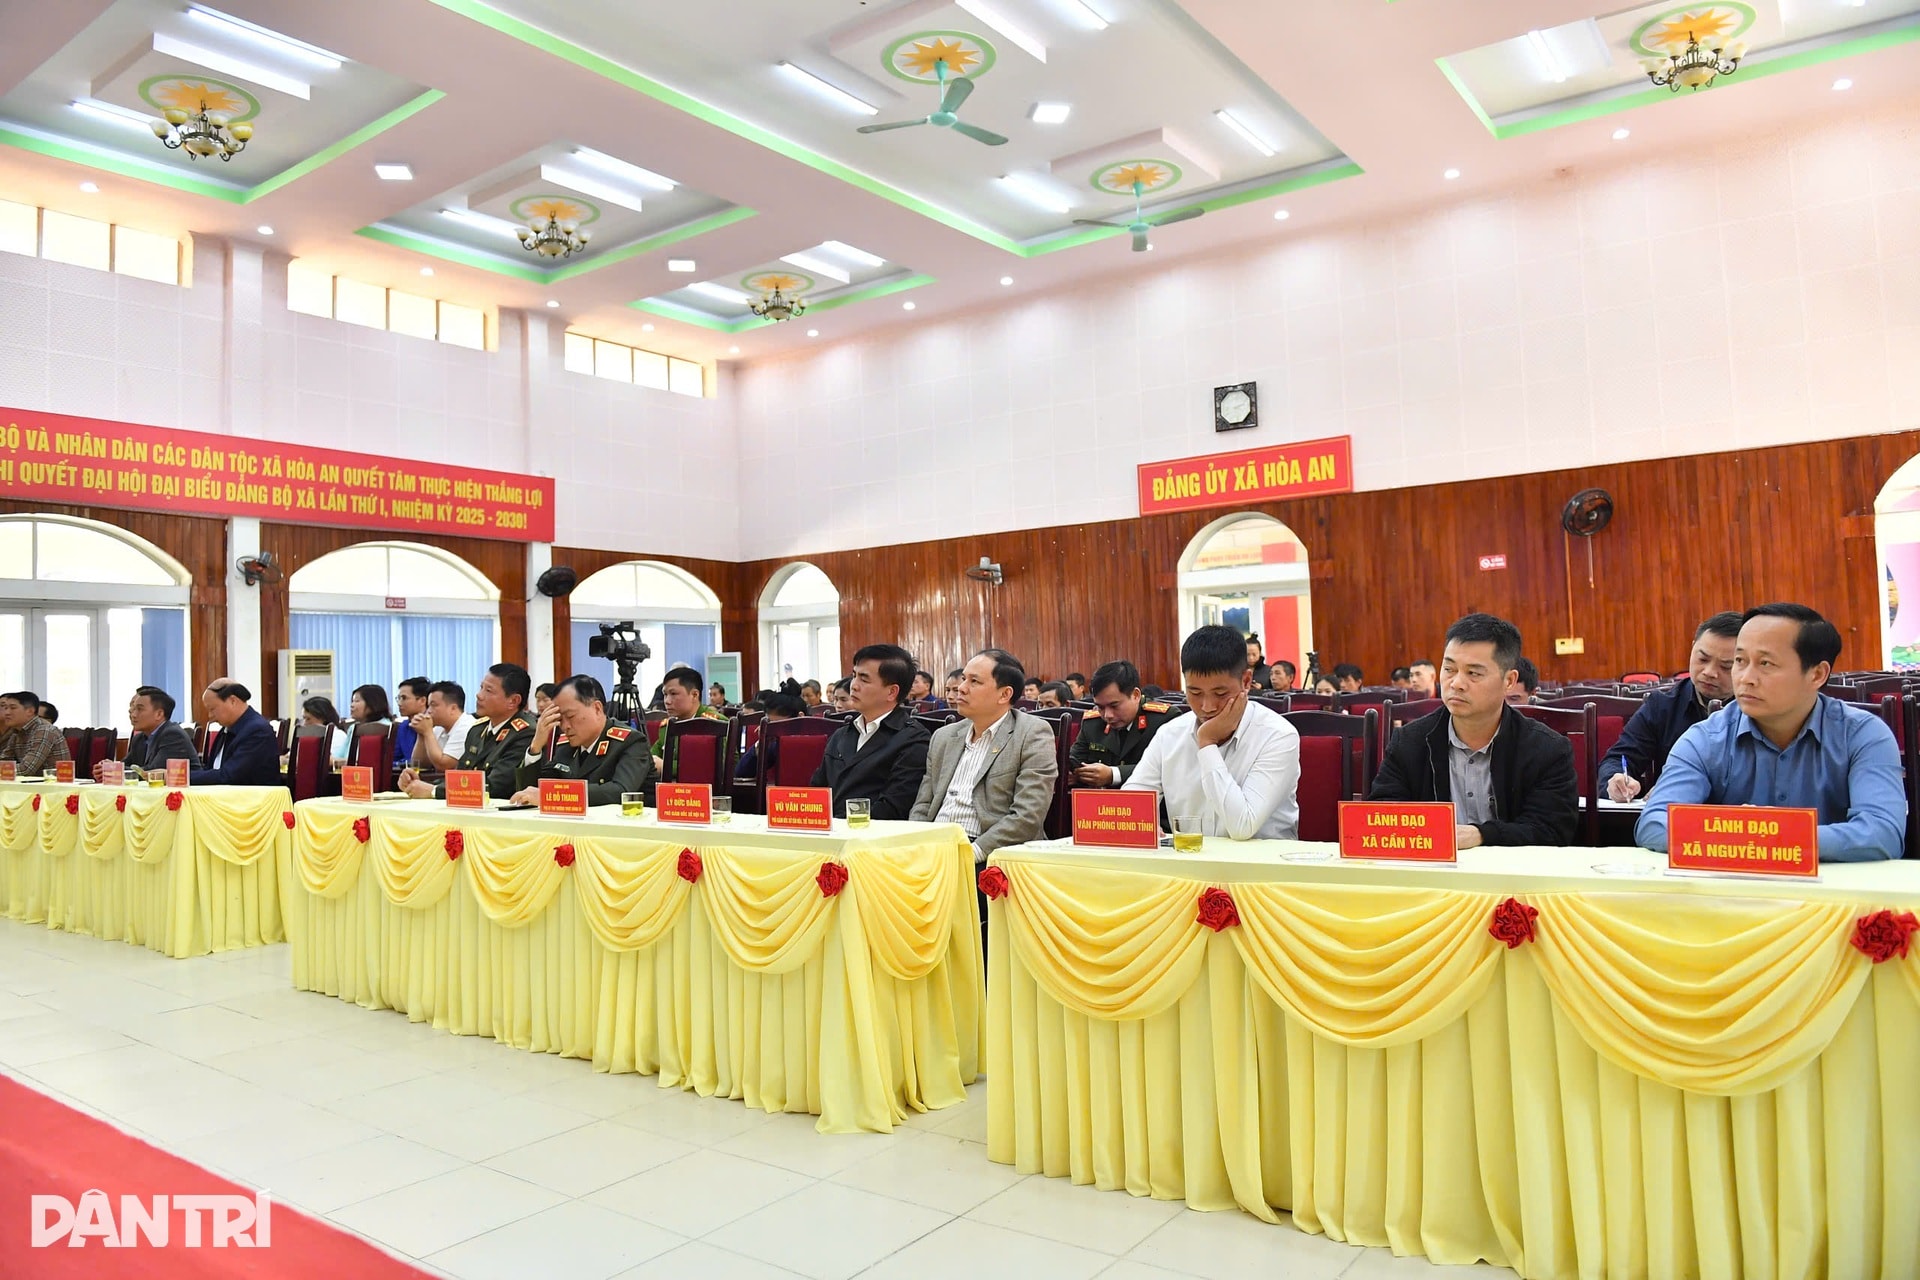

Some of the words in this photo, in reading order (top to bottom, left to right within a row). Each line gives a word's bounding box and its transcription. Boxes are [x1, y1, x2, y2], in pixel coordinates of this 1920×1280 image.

[25, 427, 50, 452] VÀ
[55, 432, 106, 459] NHÂN
[112, 437, 148, 462] DÂN
[153, 442, 186, 467] CÁC
[191, 446, 224, 471] DÂN
[229, 451, 258, 477] TỘC
[262, 456, 282, 478] XÃ
[319, 464, 339, 484] AN
[343, 465, 385, 489] QUYẾT
[388, 470, 416, 492] TÂM
[419, 476, 451, 499] THỰC
[454, 478, 482, 503] HIỆN
[485, 480, 522, 504] THẮNG
[525, 488, 543, 509] LỢI
[1152, 467, 1201, 501] ĐẢNG
[1205, 462, 1229, 495] ỦY
[1234, 460, 1259, 491] XÃ
[1264, 455, 1302, 487] HÒA
[1308, 454, 1336, 482] AN
[19, 459, 78, 487] QUYẾT
[82, 468, 112, 494] ĐẠI
[118, 469, 147, 496] HỘI
[151, 477, 180, 500] ĐẠI
[185, 473, 221, 501] BIỂU
[226, 476, 268, 505] ĐẢNG
[272, 486, 292, 511] BỘ
[296, 486, 316, 509] XÃ
[350, 493, 378, 515] THỨ
[391, 498, 434, 523] NHIỆM
[456, 506, 485, 525] 2025
[495, 511, 527, 529] 2030!
[785, 802, 799, 812] VĂN
[800, 803, 823, 813] CHUNG
[1098, 805, 1116, 817] LÃNH
[1116, 807, 1132, 819] ĐẠO
[1077, 819, 1091, 830] VĂN
[1092, 819, 1116, 831] PHÒNG
[1116, 821, 1137, 831] UBND
[1367, 812, 1398, 827] LÃNH
[1401, 814, 1426, 830] ĐẠO
[1703, 817, 1744, 834] LÃNH
[1747, 820, 1779, 838] ĐẠO
[1362, 834, 1378, 848] XÃ
[1409, 834, 1433, 850] YÊN
[1682, 840, 1703, 857] XÃ
[1706, 841, 1768, 861] NGUYỄN
[1772, 845, 1803, 865] HUỆ
